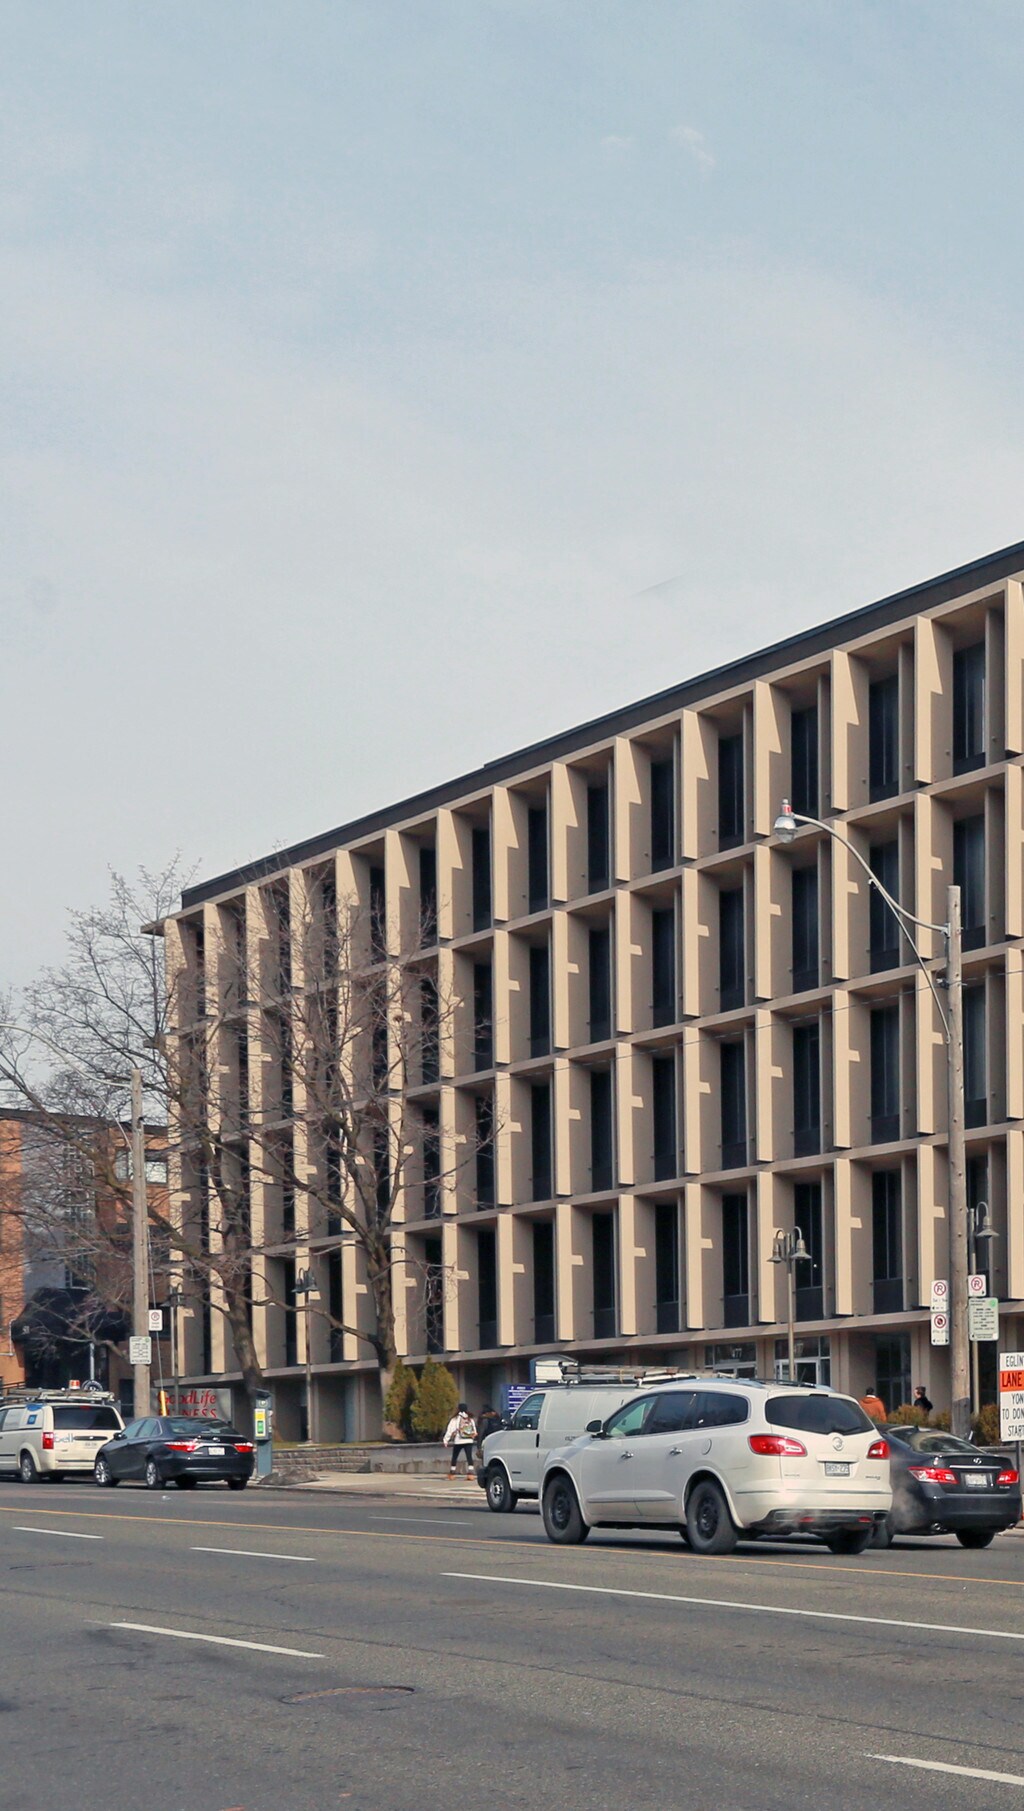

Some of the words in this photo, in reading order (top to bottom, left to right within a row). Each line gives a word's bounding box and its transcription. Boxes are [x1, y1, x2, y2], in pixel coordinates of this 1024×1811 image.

[1002, 1371, 1022, 1387] LANE
[1002, 1409, 1009, 1419] TO
[1013, 1408, 1024, 1419] DON
